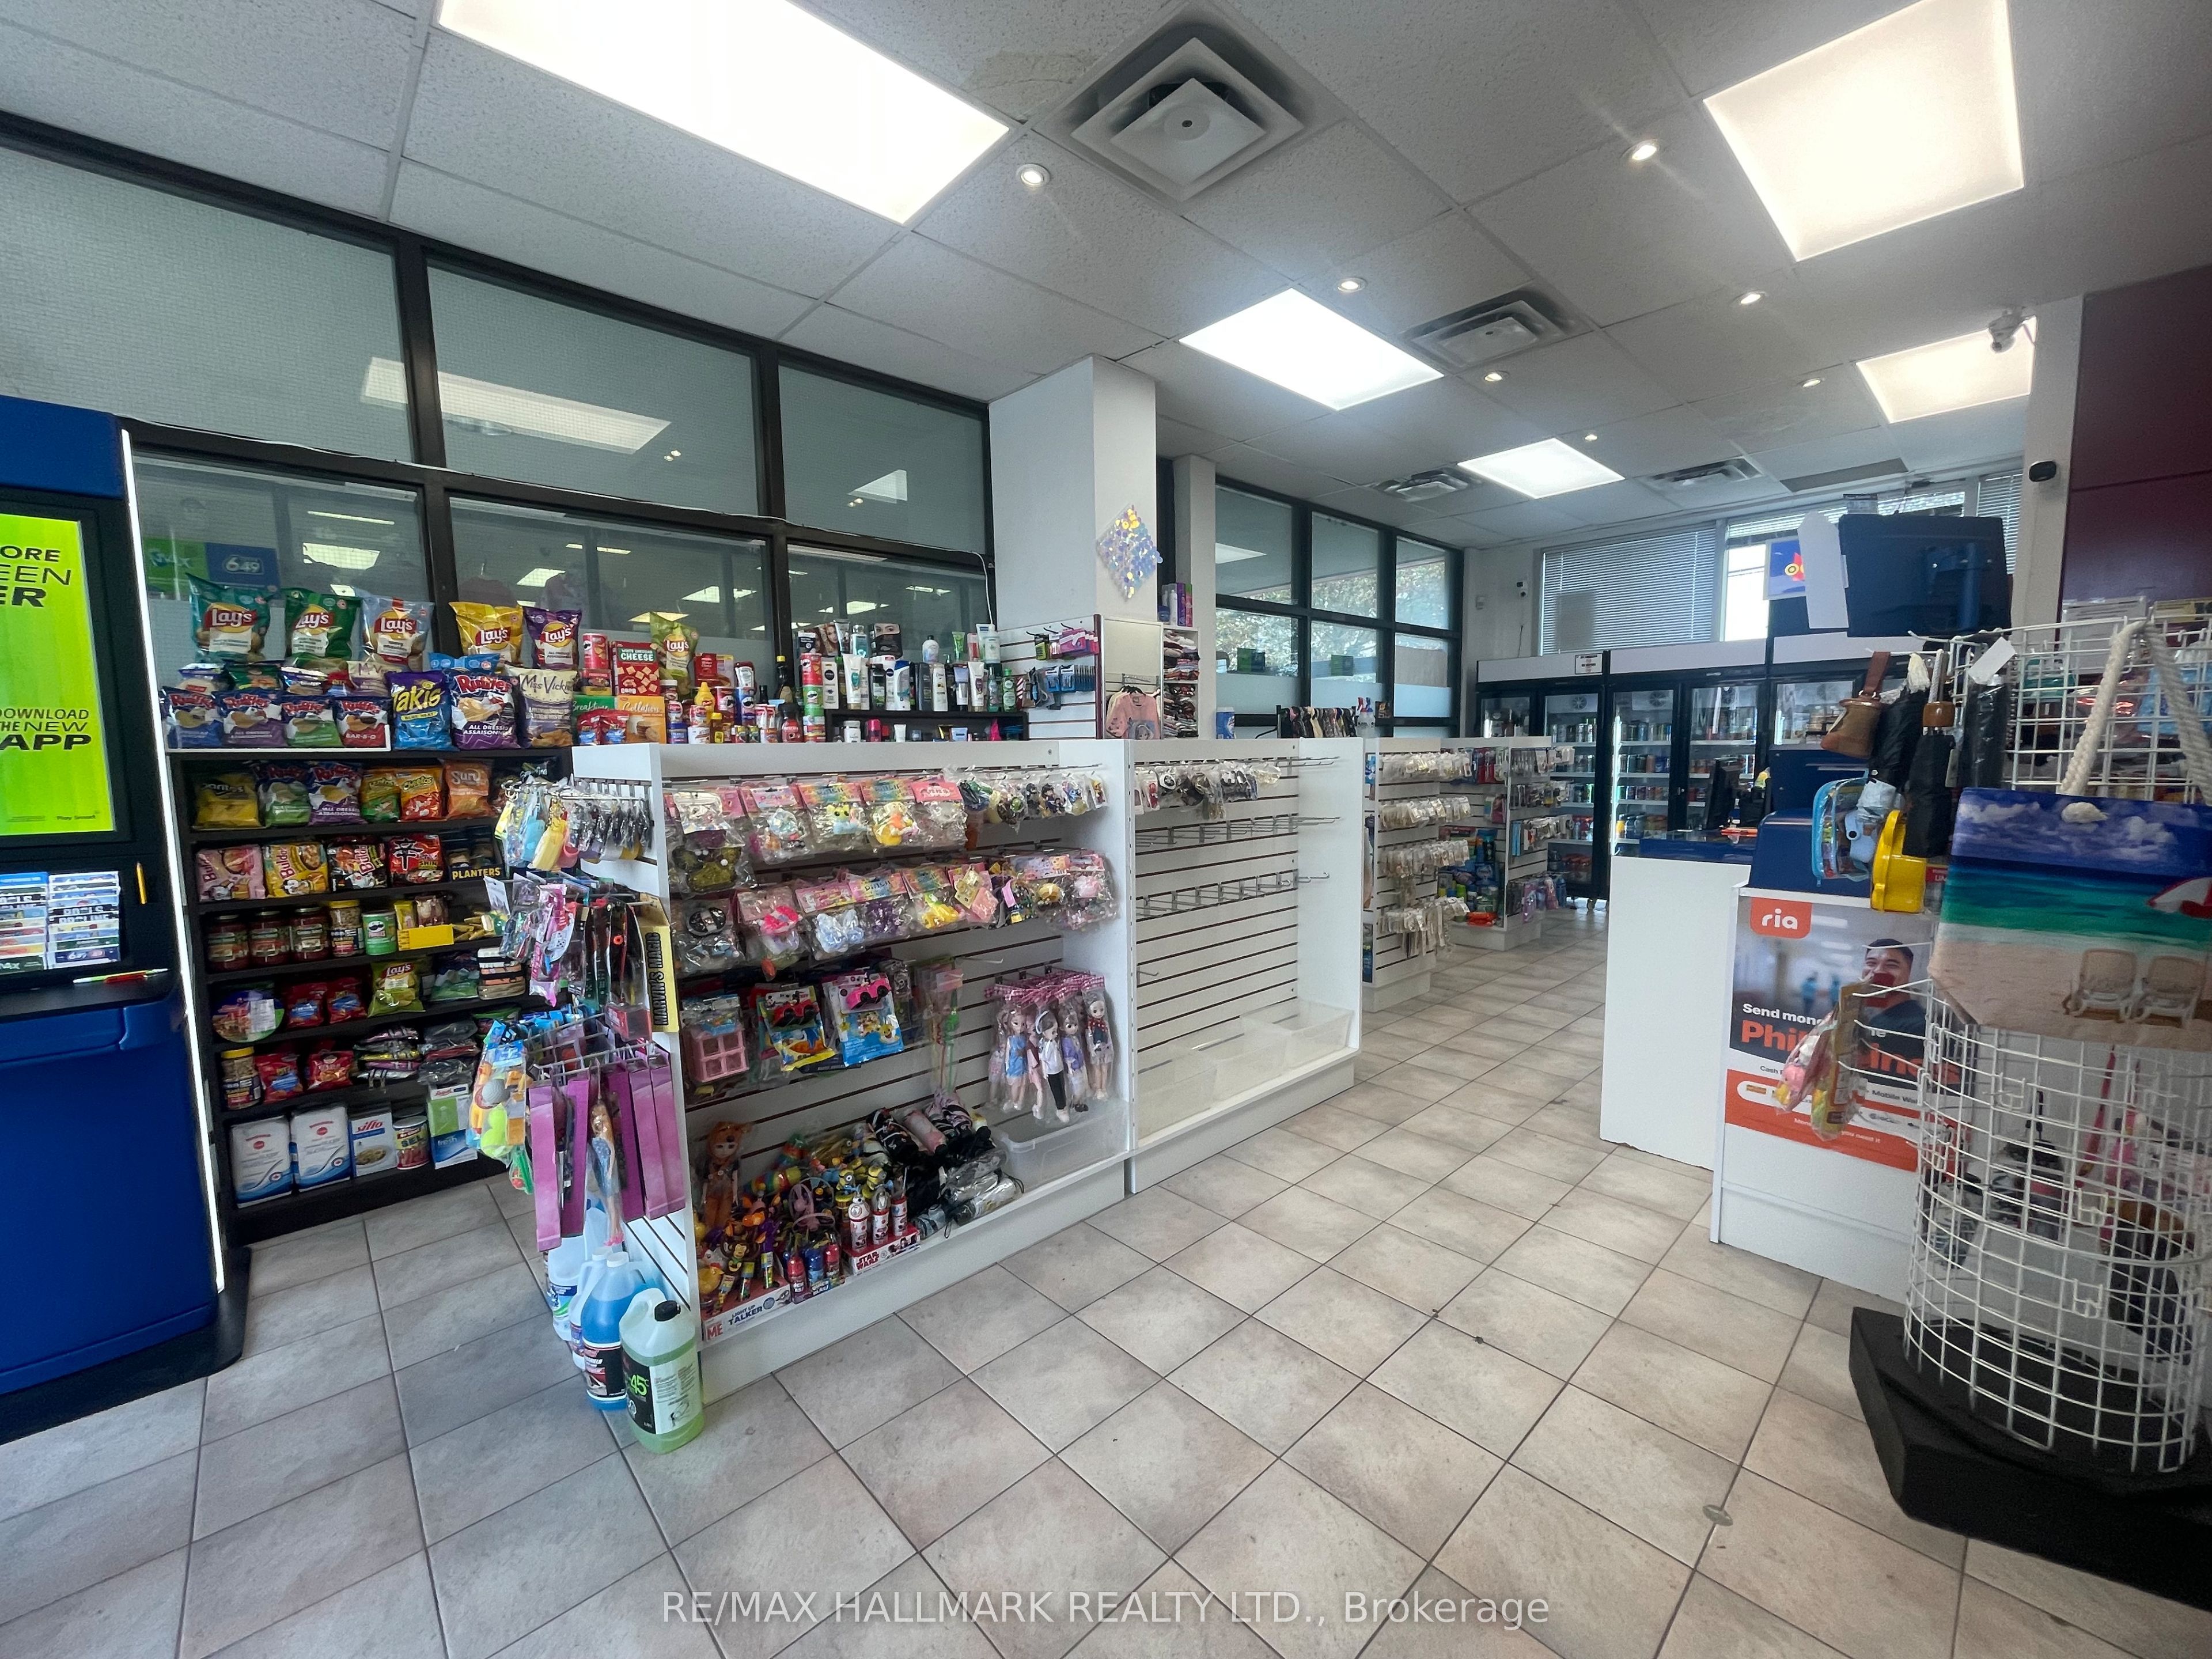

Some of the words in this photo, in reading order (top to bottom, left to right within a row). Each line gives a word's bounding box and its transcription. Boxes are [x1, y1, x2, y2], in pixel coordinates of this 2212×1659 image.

[0, 546, 60, 562] ORE
[212, 609, 252, 627] Lay's
[295, 612, 329, 628] Lay's
[380, 618, 413, 632] Lay's
[480, 628, 508, 645] Lay's
[545, 626, 572, 643] Lay's
[666, 640, 690, 653] Lay's
[620, 653, 654, 661] CHEESE
[521, 675, 542, 692] Miss
[391, 684, 442, 712] Takis
[0, 709, 89, 719] OWNLOAD
[623, 701, 660, 713] Collation
[24, 722, 88, 732] NEW
[0, 734, 92, 750] APP
[452, 867, 501, 880] PLANTERS
[1762, 908, 1798, 929] ria
[645, 932, 663, 968] MAGIC
[387, 963, 412, 976] Lay's
[649, 971, 668, 1025] MARVIN'S
[1743, 1003, 1780, 1018] Send
[1782, 1012, 1822, 1025] mone
[1760, 1066, 1779, 1074] Cash
[1872, 1090, 1900, 1100] Mobile
[437, 1136, 457, 1147] fresh
[856, 1254, 880, 1270] WARS
[858, 1251, 879, 1263] STAR
[728, 1306, 763, 1325] TALKER
[732, 1307, 748, 1319] LIGHT
[707, 1323, 724, 1340] ME
